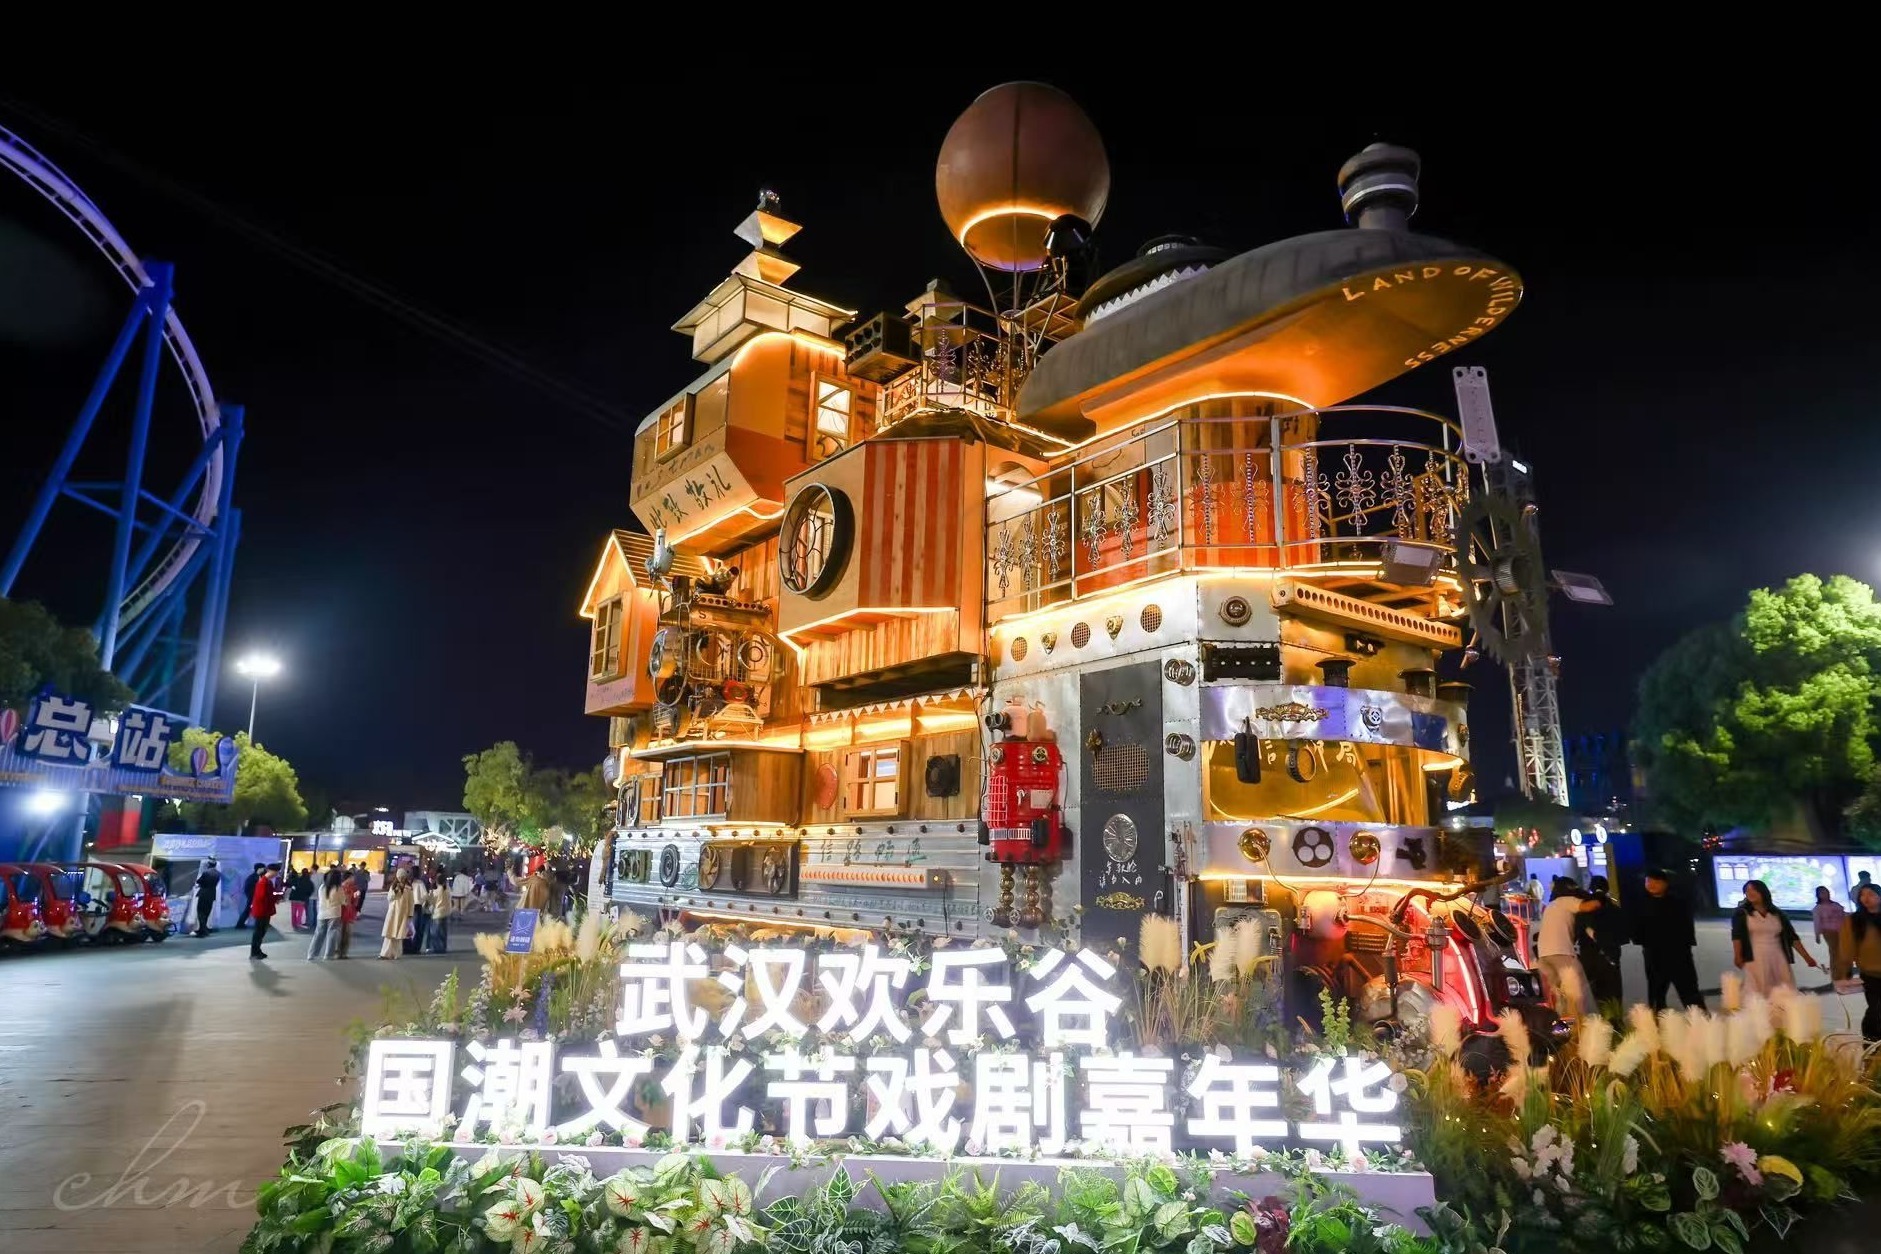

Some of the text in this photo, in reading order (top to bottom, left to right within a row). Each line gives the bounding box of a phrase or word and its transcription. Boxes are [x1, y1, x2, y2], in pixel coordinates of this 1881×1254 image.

[1342, 266, 1515, 370] LAND OF WILDERNESS
[24, 696, 171, 770] 总站
[616, 942, 1123, 1048] 武汉欢乐谷
[359, 1038, 1404, 1161] 国潮文化节戏剧嘉年华
